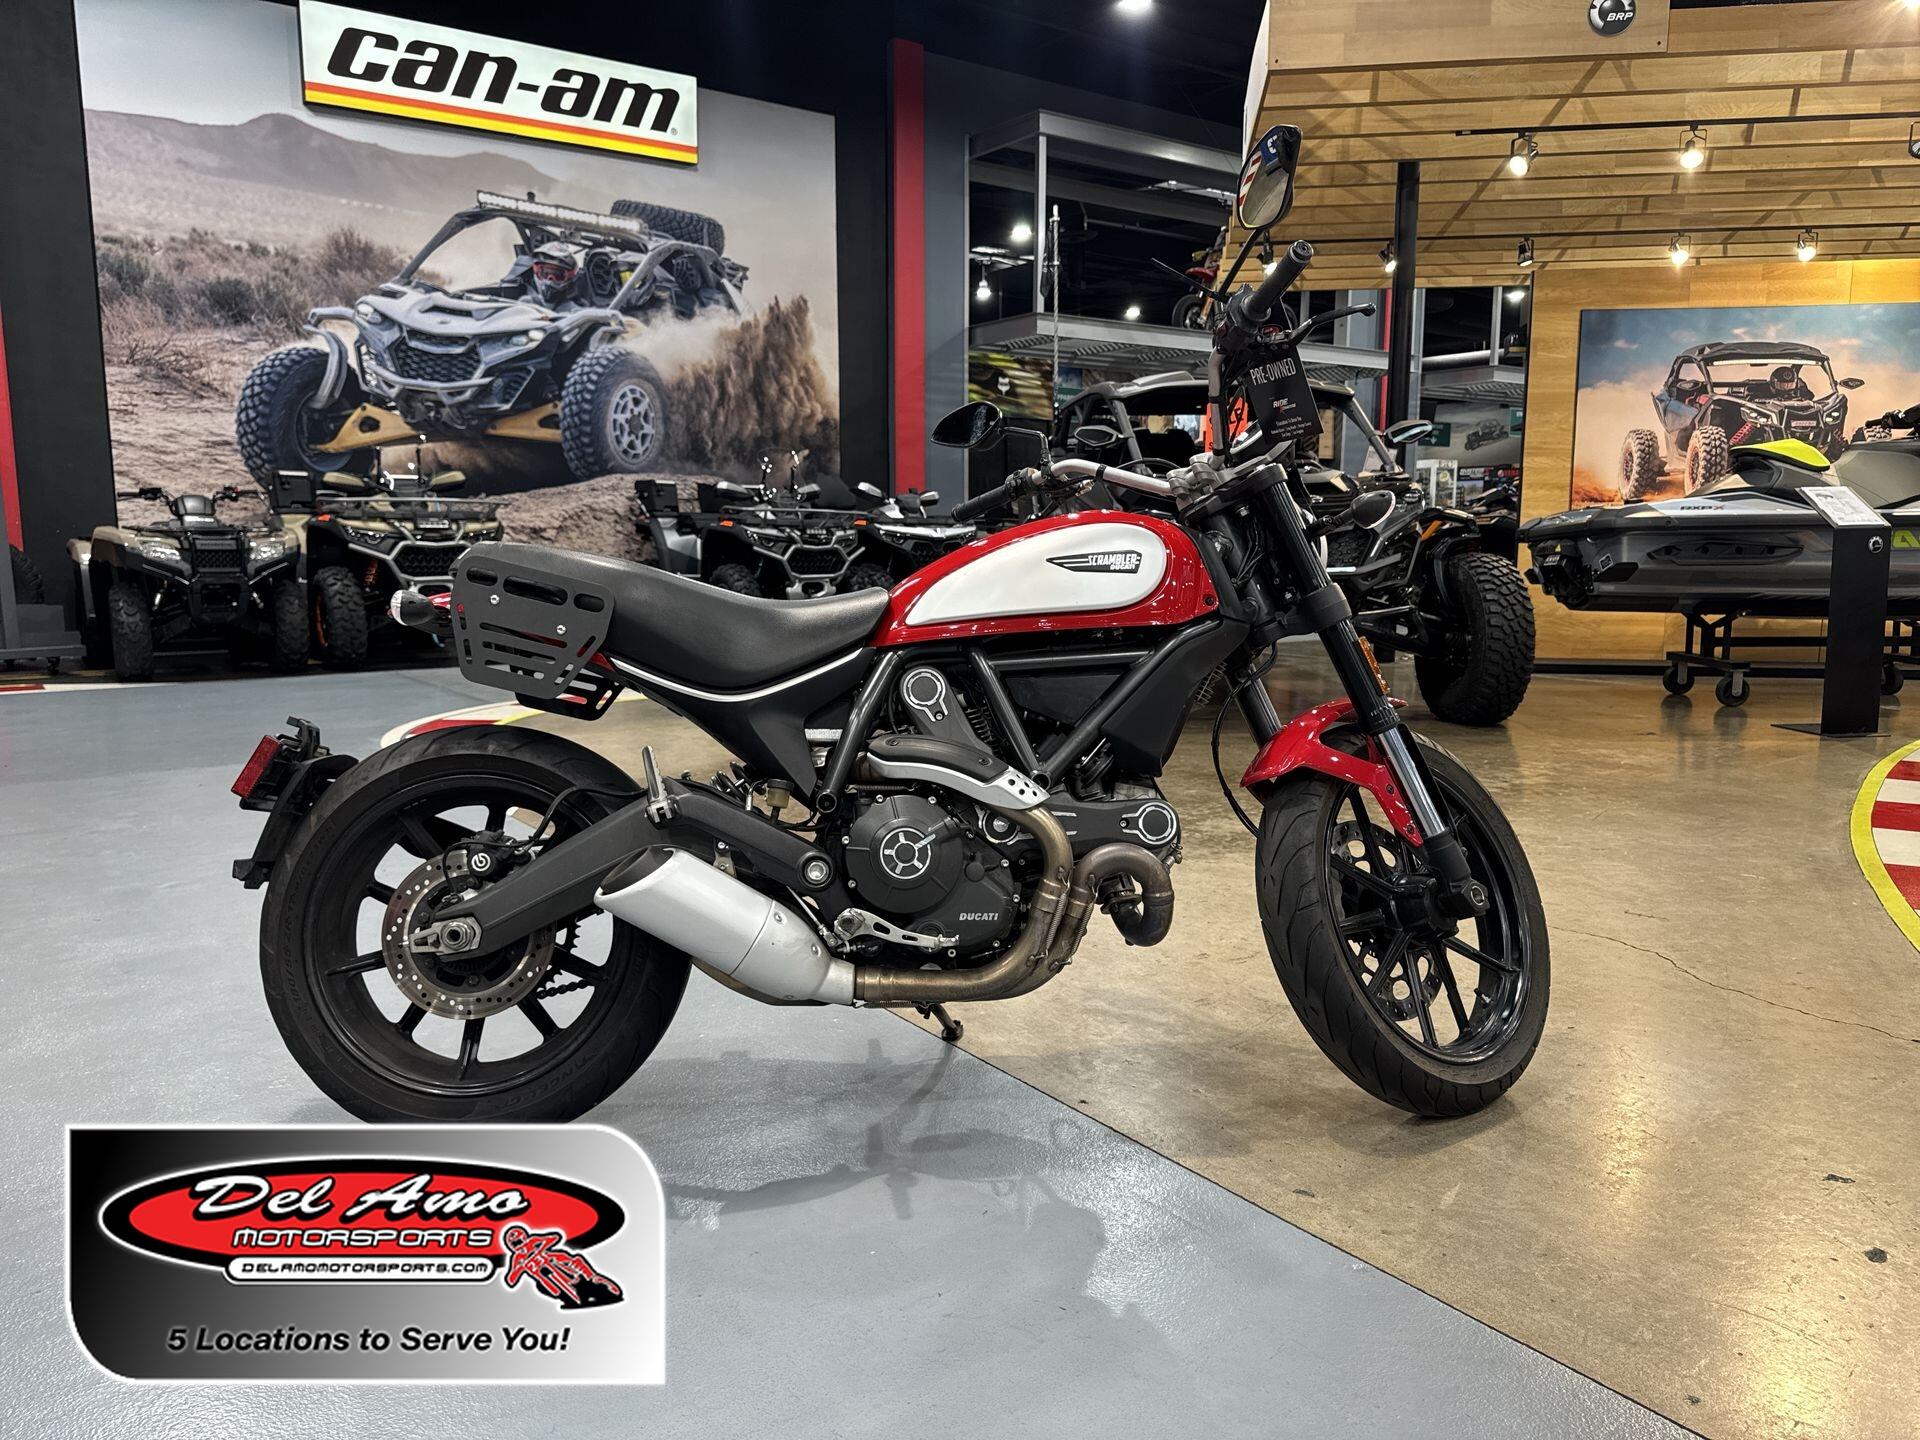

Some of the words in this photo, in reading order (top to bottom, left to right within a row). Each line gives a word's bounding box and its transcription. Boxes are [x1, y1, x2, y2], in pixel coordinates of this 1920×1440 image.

[1606, 12, 1633, 21] BRP
[327, 27, 680, 132] can-am
[1250, 358, 1297, 386] PRE-OWNED
[1273, 398, 1288, 408] RIDE
[1087, 554, 1137, 566] SCRAMBLER
[959, 912, 999, 921] DUCATI
